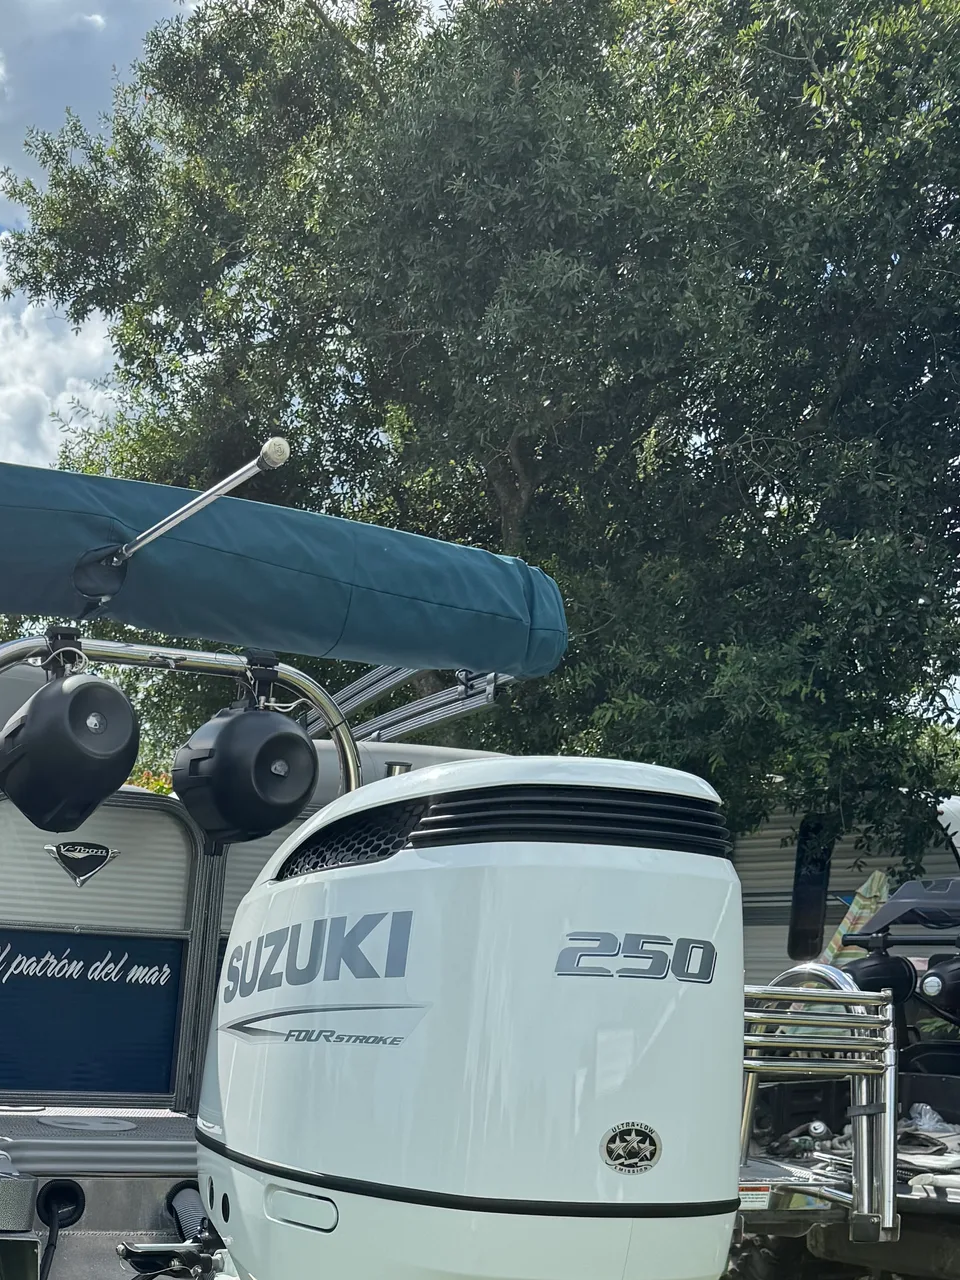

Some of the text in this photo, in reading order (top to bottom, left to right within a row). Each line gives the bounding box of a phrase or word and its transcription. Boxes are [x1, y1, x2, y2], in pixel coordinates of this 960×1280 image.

[59, 844, 108, 857] V-Toon
[1, 948, 85, 984] patrón
[87, 950, 129, 982] del
[125, 963, 172, 986] mar
[223, 910, 414, 1004] SUZUKI
[554, 931, 718, 985] 250
